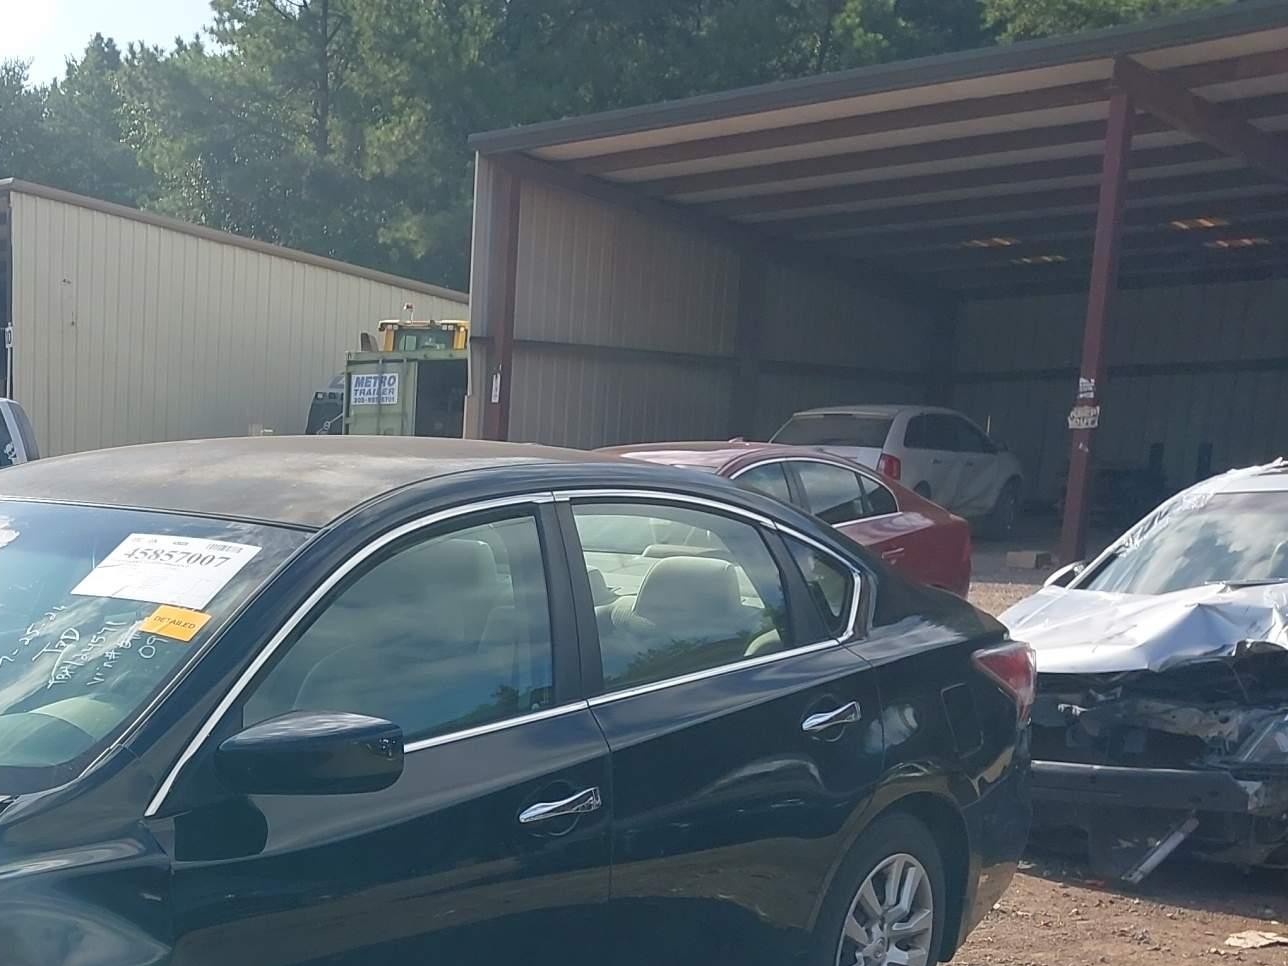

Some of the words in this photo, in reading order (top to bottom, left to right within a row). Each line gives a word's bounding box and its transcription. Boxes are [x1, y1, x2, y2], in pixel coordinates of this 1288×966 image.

[354, 375, 397, 387] METRO
[124, 547, 231, 568] 45857007
[154, 615, 196, 630] DETAILED
